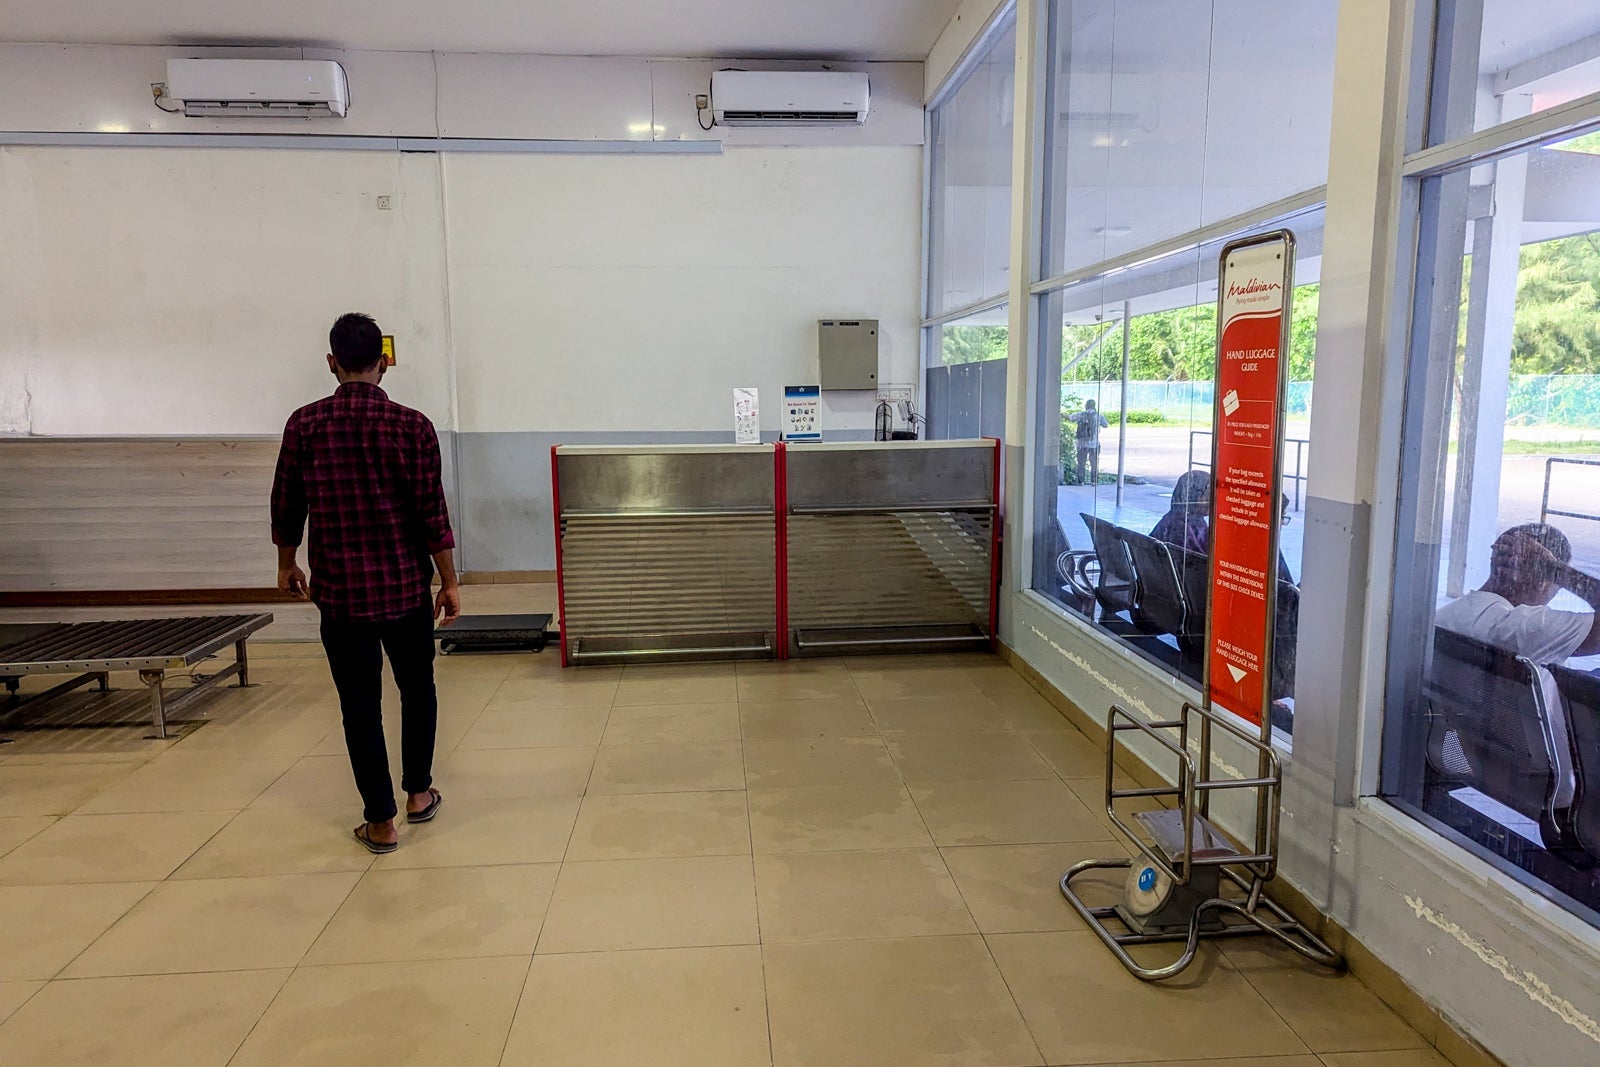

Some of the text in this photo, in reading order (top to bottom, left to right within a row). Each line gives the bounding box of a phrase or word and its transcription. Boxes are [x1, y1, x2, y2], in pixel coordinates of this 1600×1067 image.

[1227, 278, 1281, 299] Maldivian
[1226, 349, 1276, 360] HAND LUGGAGE
[1241, 362, 1259, 372] GUIDE
[1240, 469, 1248, 477] bag
[1248, 480, 1267, 488] allowance
[1240, 499, 1257, 508] baggage
[1231, 506, 1244, 514] include
[1219, 513, 1234, 521] checked
[1234, 516, 1250, 526] baggage
[1219, 560, 1230, 568] YOUR
[1230, 563, 1249, 574] HANDBAG
[1248, 568, 1260, 577] MUST
[1220, 570, 1233, 579] WITHIN
[1240, 576, 1264, 589] DIMENSIONS
[1230, 583, 1238, 591] SIZE
[1238, 586, 1250, 595] CHECK
[1217, 639, 1258, 662] PLEASE WEIGH YOUR
[1216, 647, 1259, 672] HAND LUGGAGE HERE
